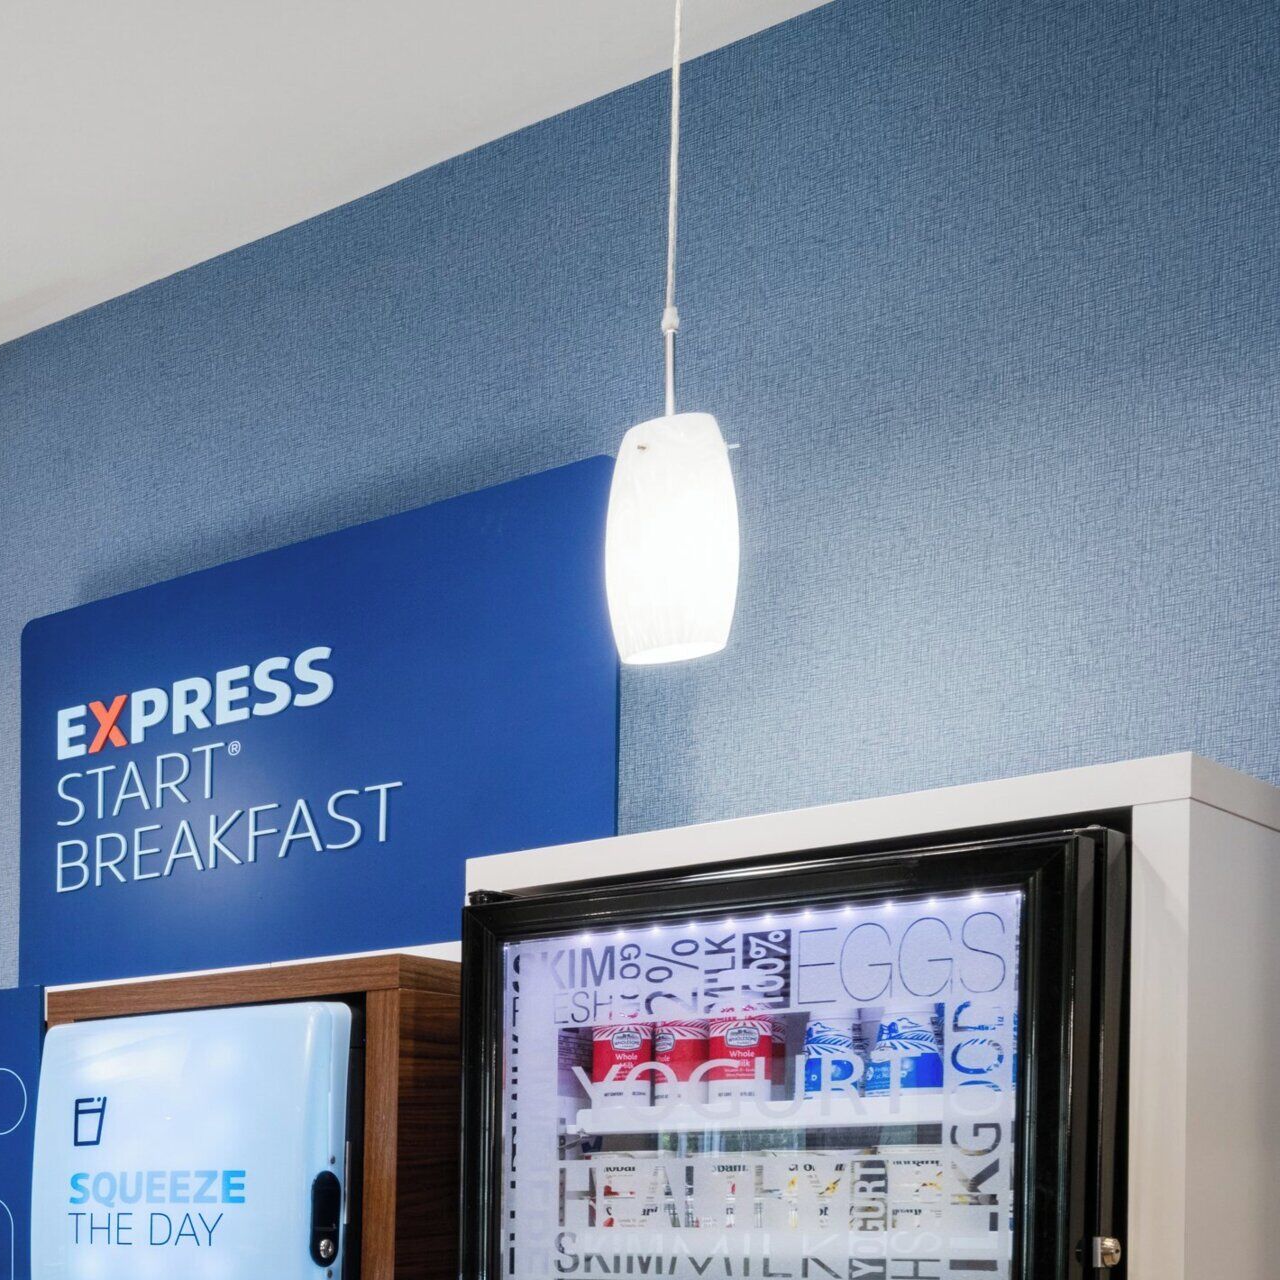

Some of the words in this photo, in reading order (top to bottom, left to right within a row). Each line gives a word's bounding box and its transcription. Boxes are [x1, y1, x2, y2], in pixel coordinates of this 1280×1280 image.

[57, 647, 334, 760] EXPRESS
[56, 781, 403, 893] BREAKFAST
[797, 912, 1007, 1004] EGGS
[615, 1053, 638, 1061] Whole
[729, 1050, 755, 1058] Whole
[572, 1053, 922, 1122] YOGURT
[69, 1169, 246, 1207] SQUEEZE
[68, 1212, 132, 1245] THE
[150, 1212, 224, 1246] DAY
